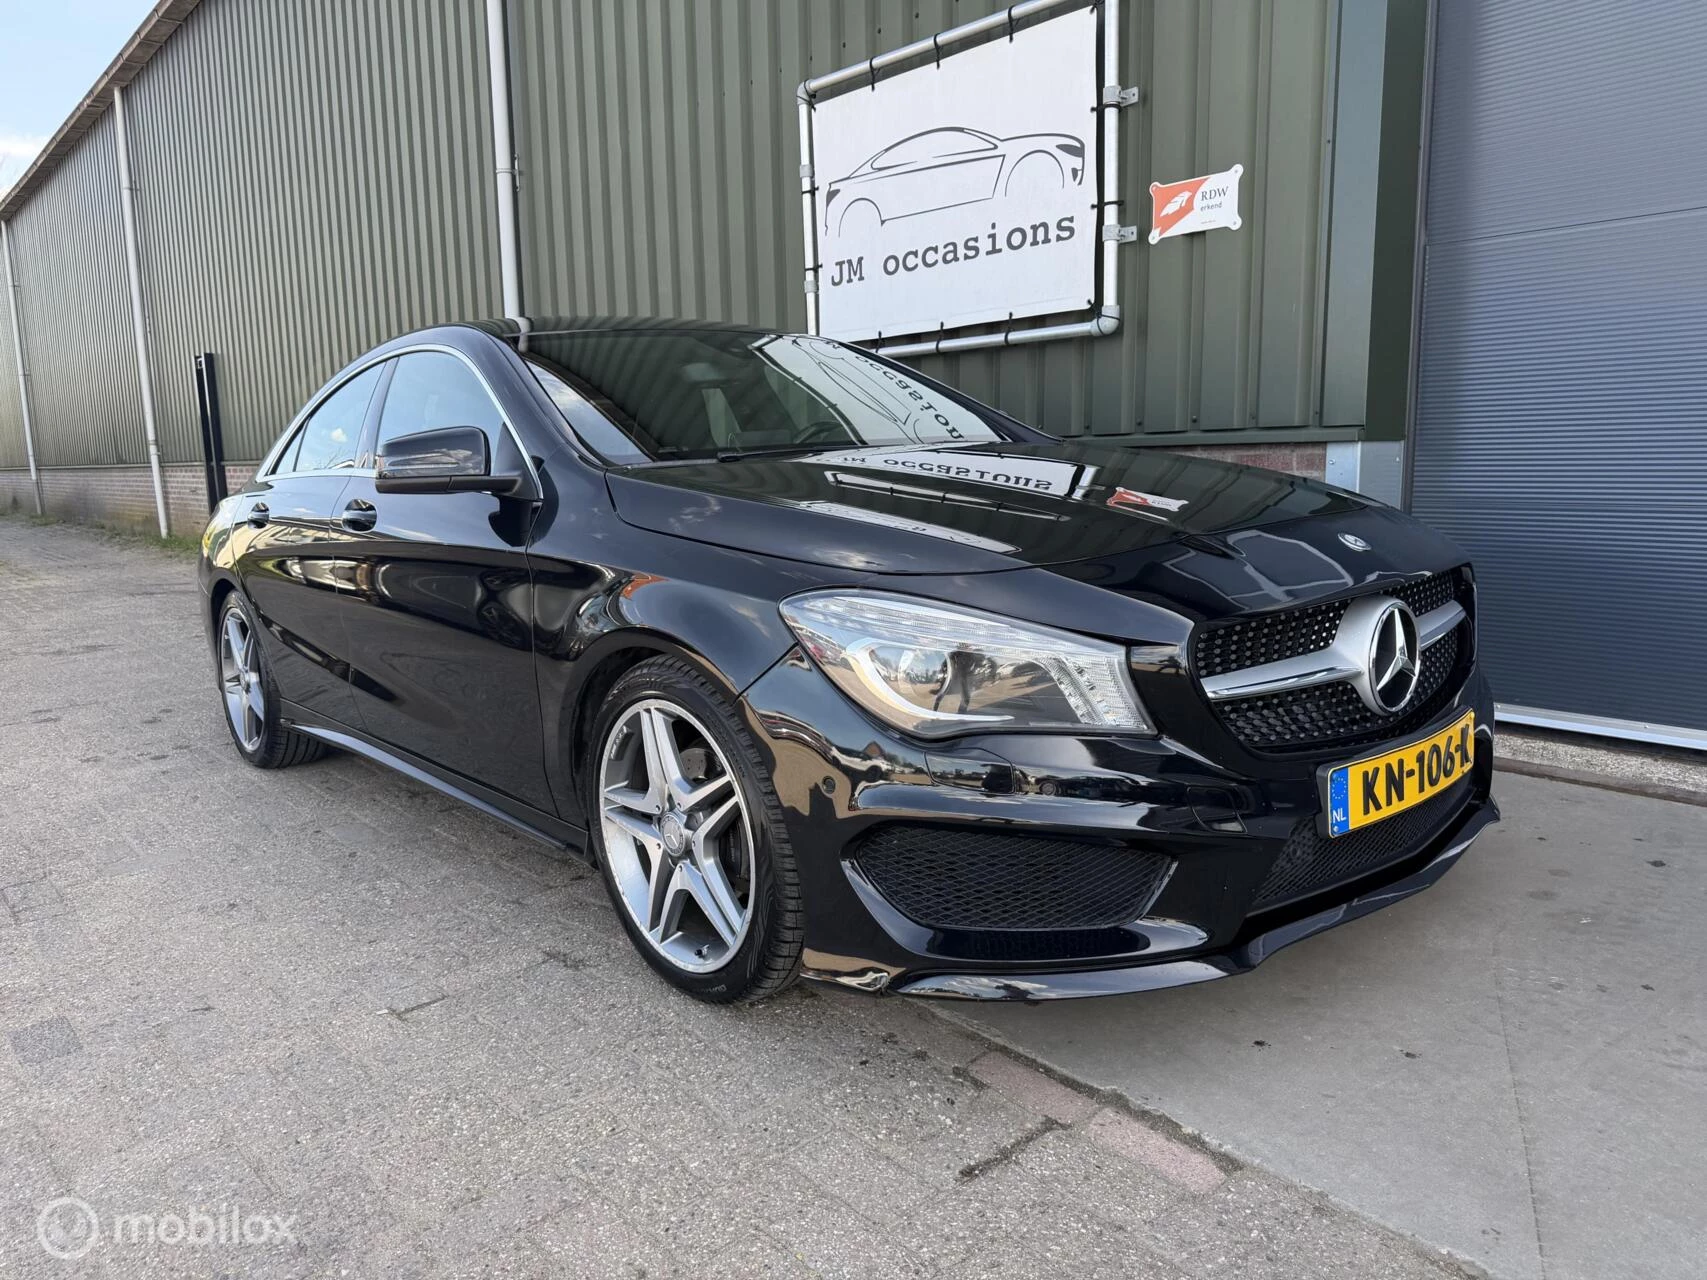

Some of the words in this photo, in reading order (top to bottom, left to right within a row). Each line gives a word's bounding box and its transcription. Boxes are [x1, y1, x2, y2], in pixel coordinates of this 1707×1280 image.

[1201, 186, 1229, 201] RDW
[1200, 201, 1223, 212] erkend
[831, 256, 865, 287] JM
[883, 215, 1076, 277] occasions
[1362, 723, 1471, 816] KN-106-K
[1332, 807, 1347, 824] NL
